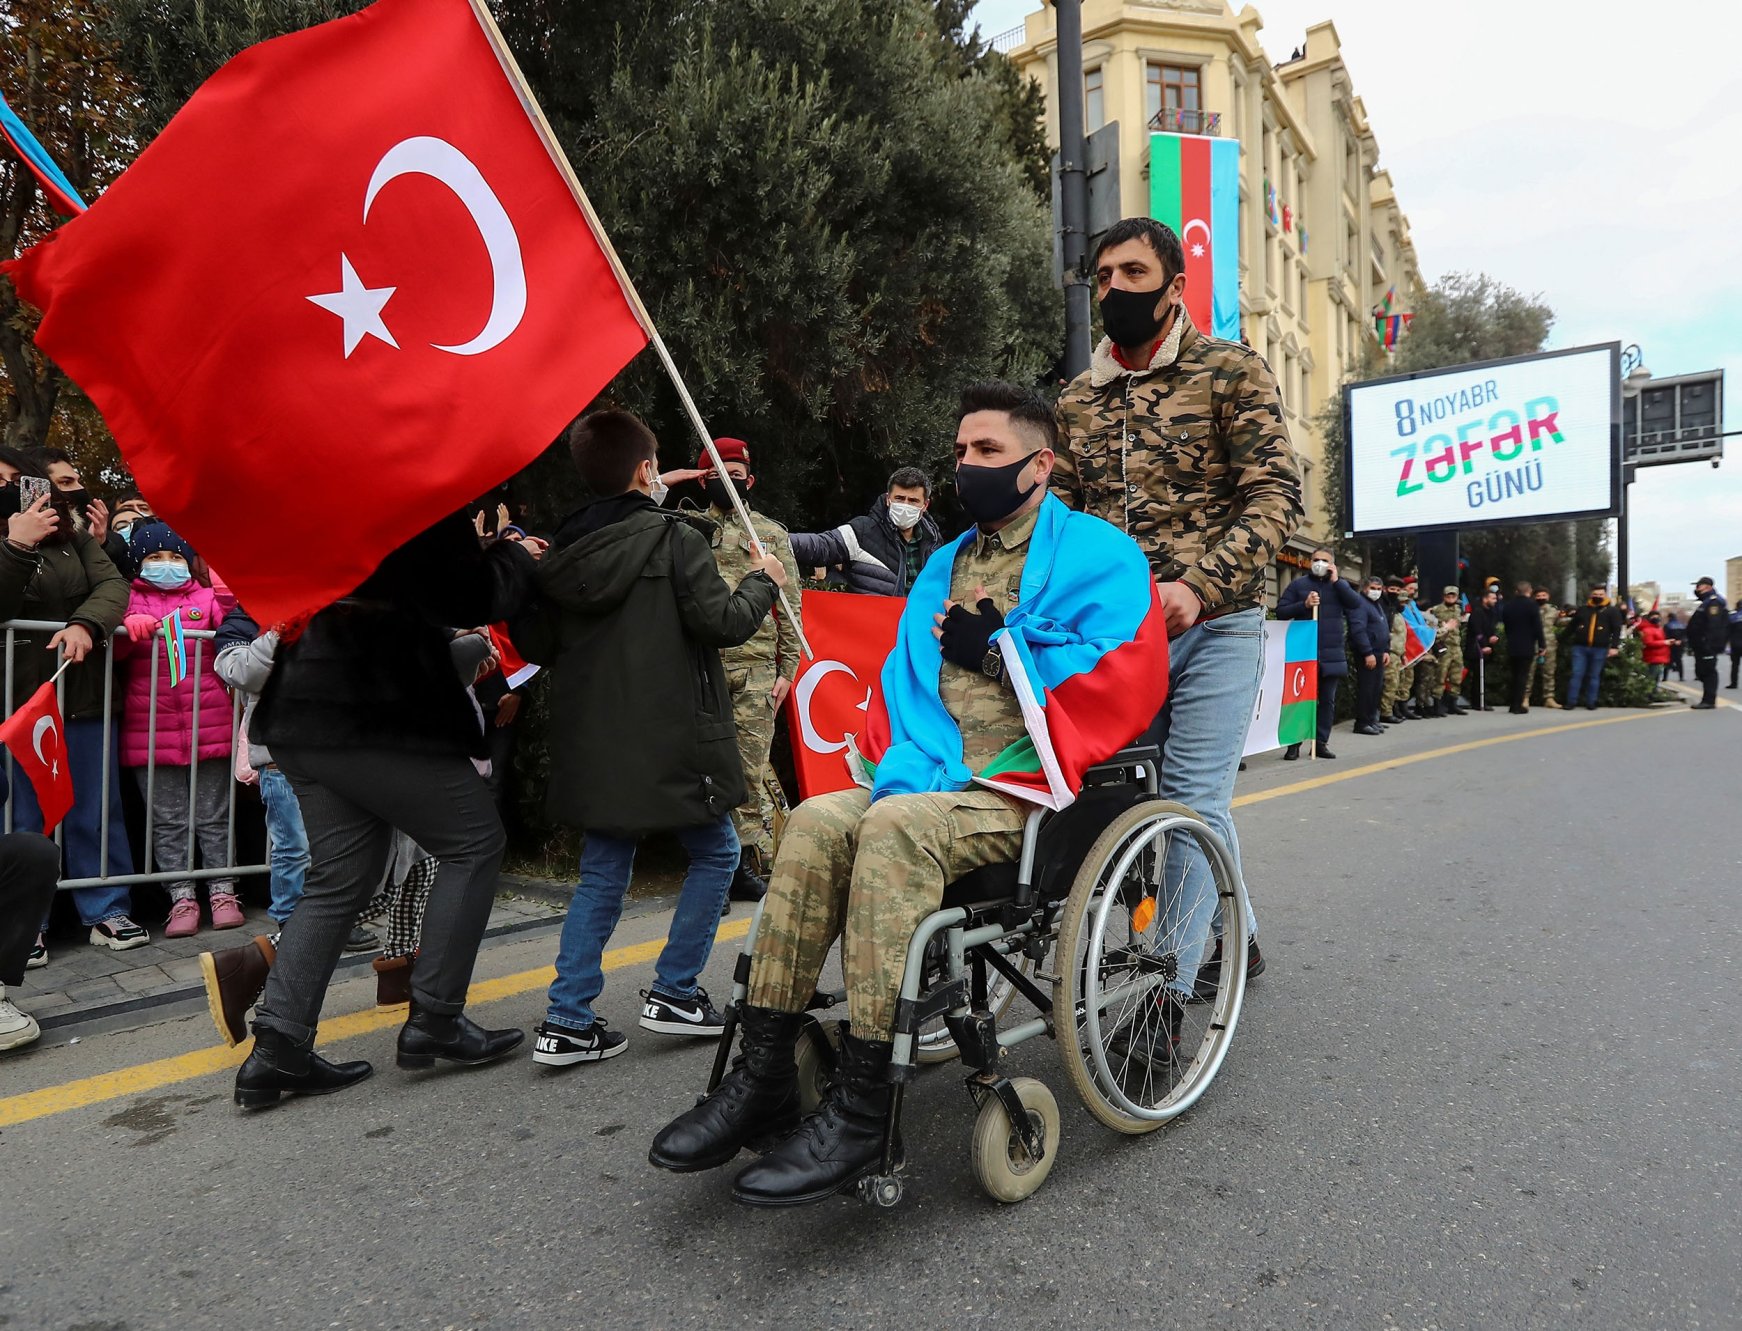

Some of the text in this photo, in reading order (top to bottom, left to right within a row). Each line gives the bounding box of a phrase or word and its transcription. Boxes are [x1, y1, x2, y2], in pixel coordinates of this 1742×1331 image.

[1394, 380, 1498, 437] 8 NOYABR
[1467, 458, 1544, 509] GÜNÜ
[536, 1035, 559, 1053] IKE
